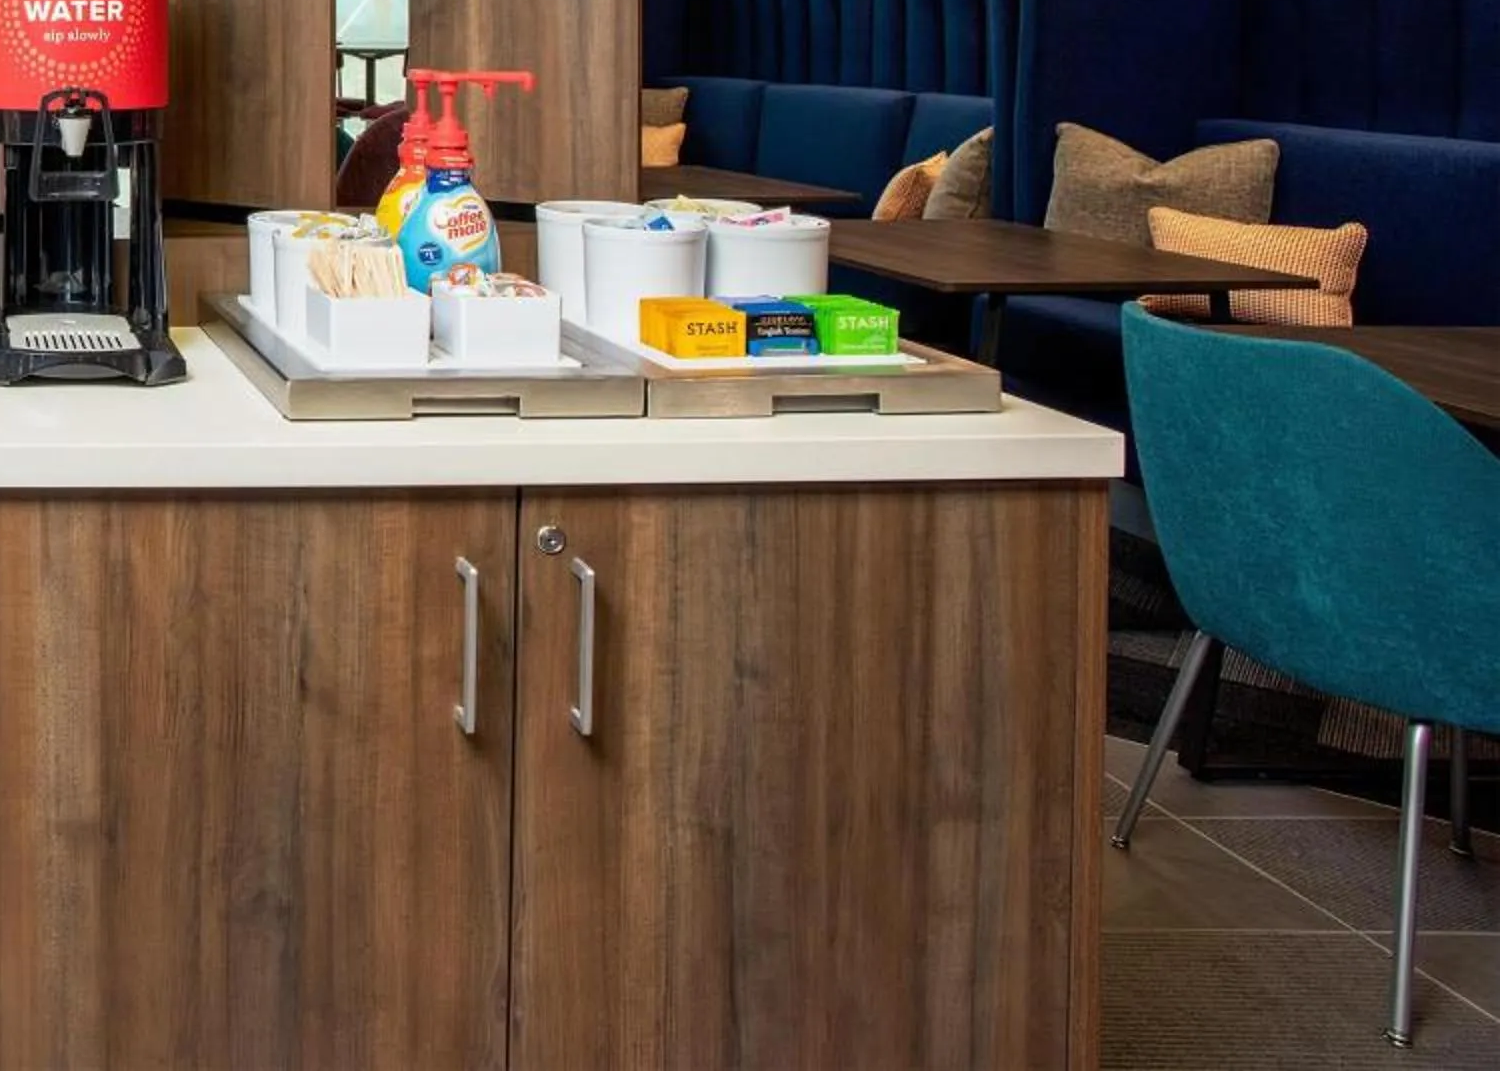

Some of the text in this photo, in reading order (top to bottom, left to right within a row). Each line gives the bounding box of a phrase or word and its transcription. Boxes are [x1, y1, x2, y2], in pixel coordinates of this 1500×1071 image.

[23, 0, 125, 22] WATER
[43, 28, 111, 43] sip slowly
[686, 321, 739, 336] STASH
[835, 315, 890, 331] STASH
